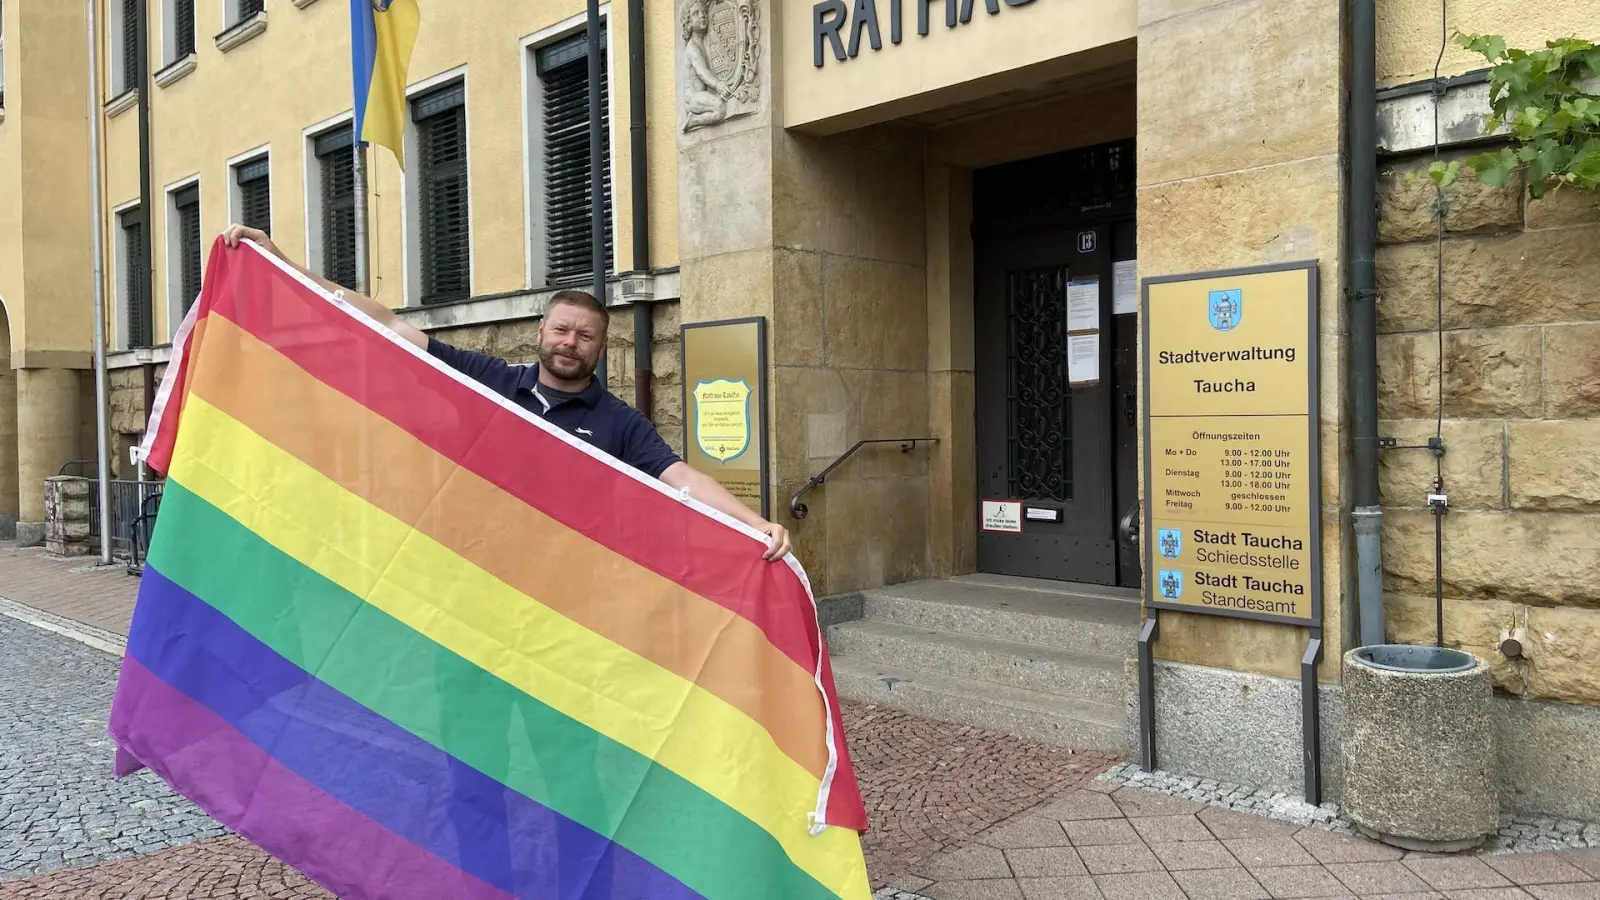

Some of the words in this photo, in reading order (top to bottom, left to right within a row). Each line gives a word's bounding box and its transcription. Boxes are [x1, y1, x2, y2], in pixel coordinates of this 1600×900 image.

[1082, 234, 1092, 249] 13
[1159, 346, 1296, 364] Stadtverwaltung
[1194, 379, 1256, 393] Taucha
[1192, 431, 1260, 442] Öffnungszeiten
[1165, 469, 1200, 478] Dienstag
[1166, 489, 1201, 497] Mittwoch
[1231, 492, 1285, 501] geschlossen
[1166, 500, 1193, 509] Freitag
[1250, 504, 1273, 512] 12.00
[1275, 505, 1291, 513] Uhr
[1193, 529, 1237, 546] Stadt
[1241, 532, 1303, 550] Taucha
[1196, 548, 1300, 570] Schiedsstelle
[1195, 571, 1238, 589] Stadt
[1242, 576, 1304, 595] Taucha
[1202, 590, 1297, 614] Standesamt
